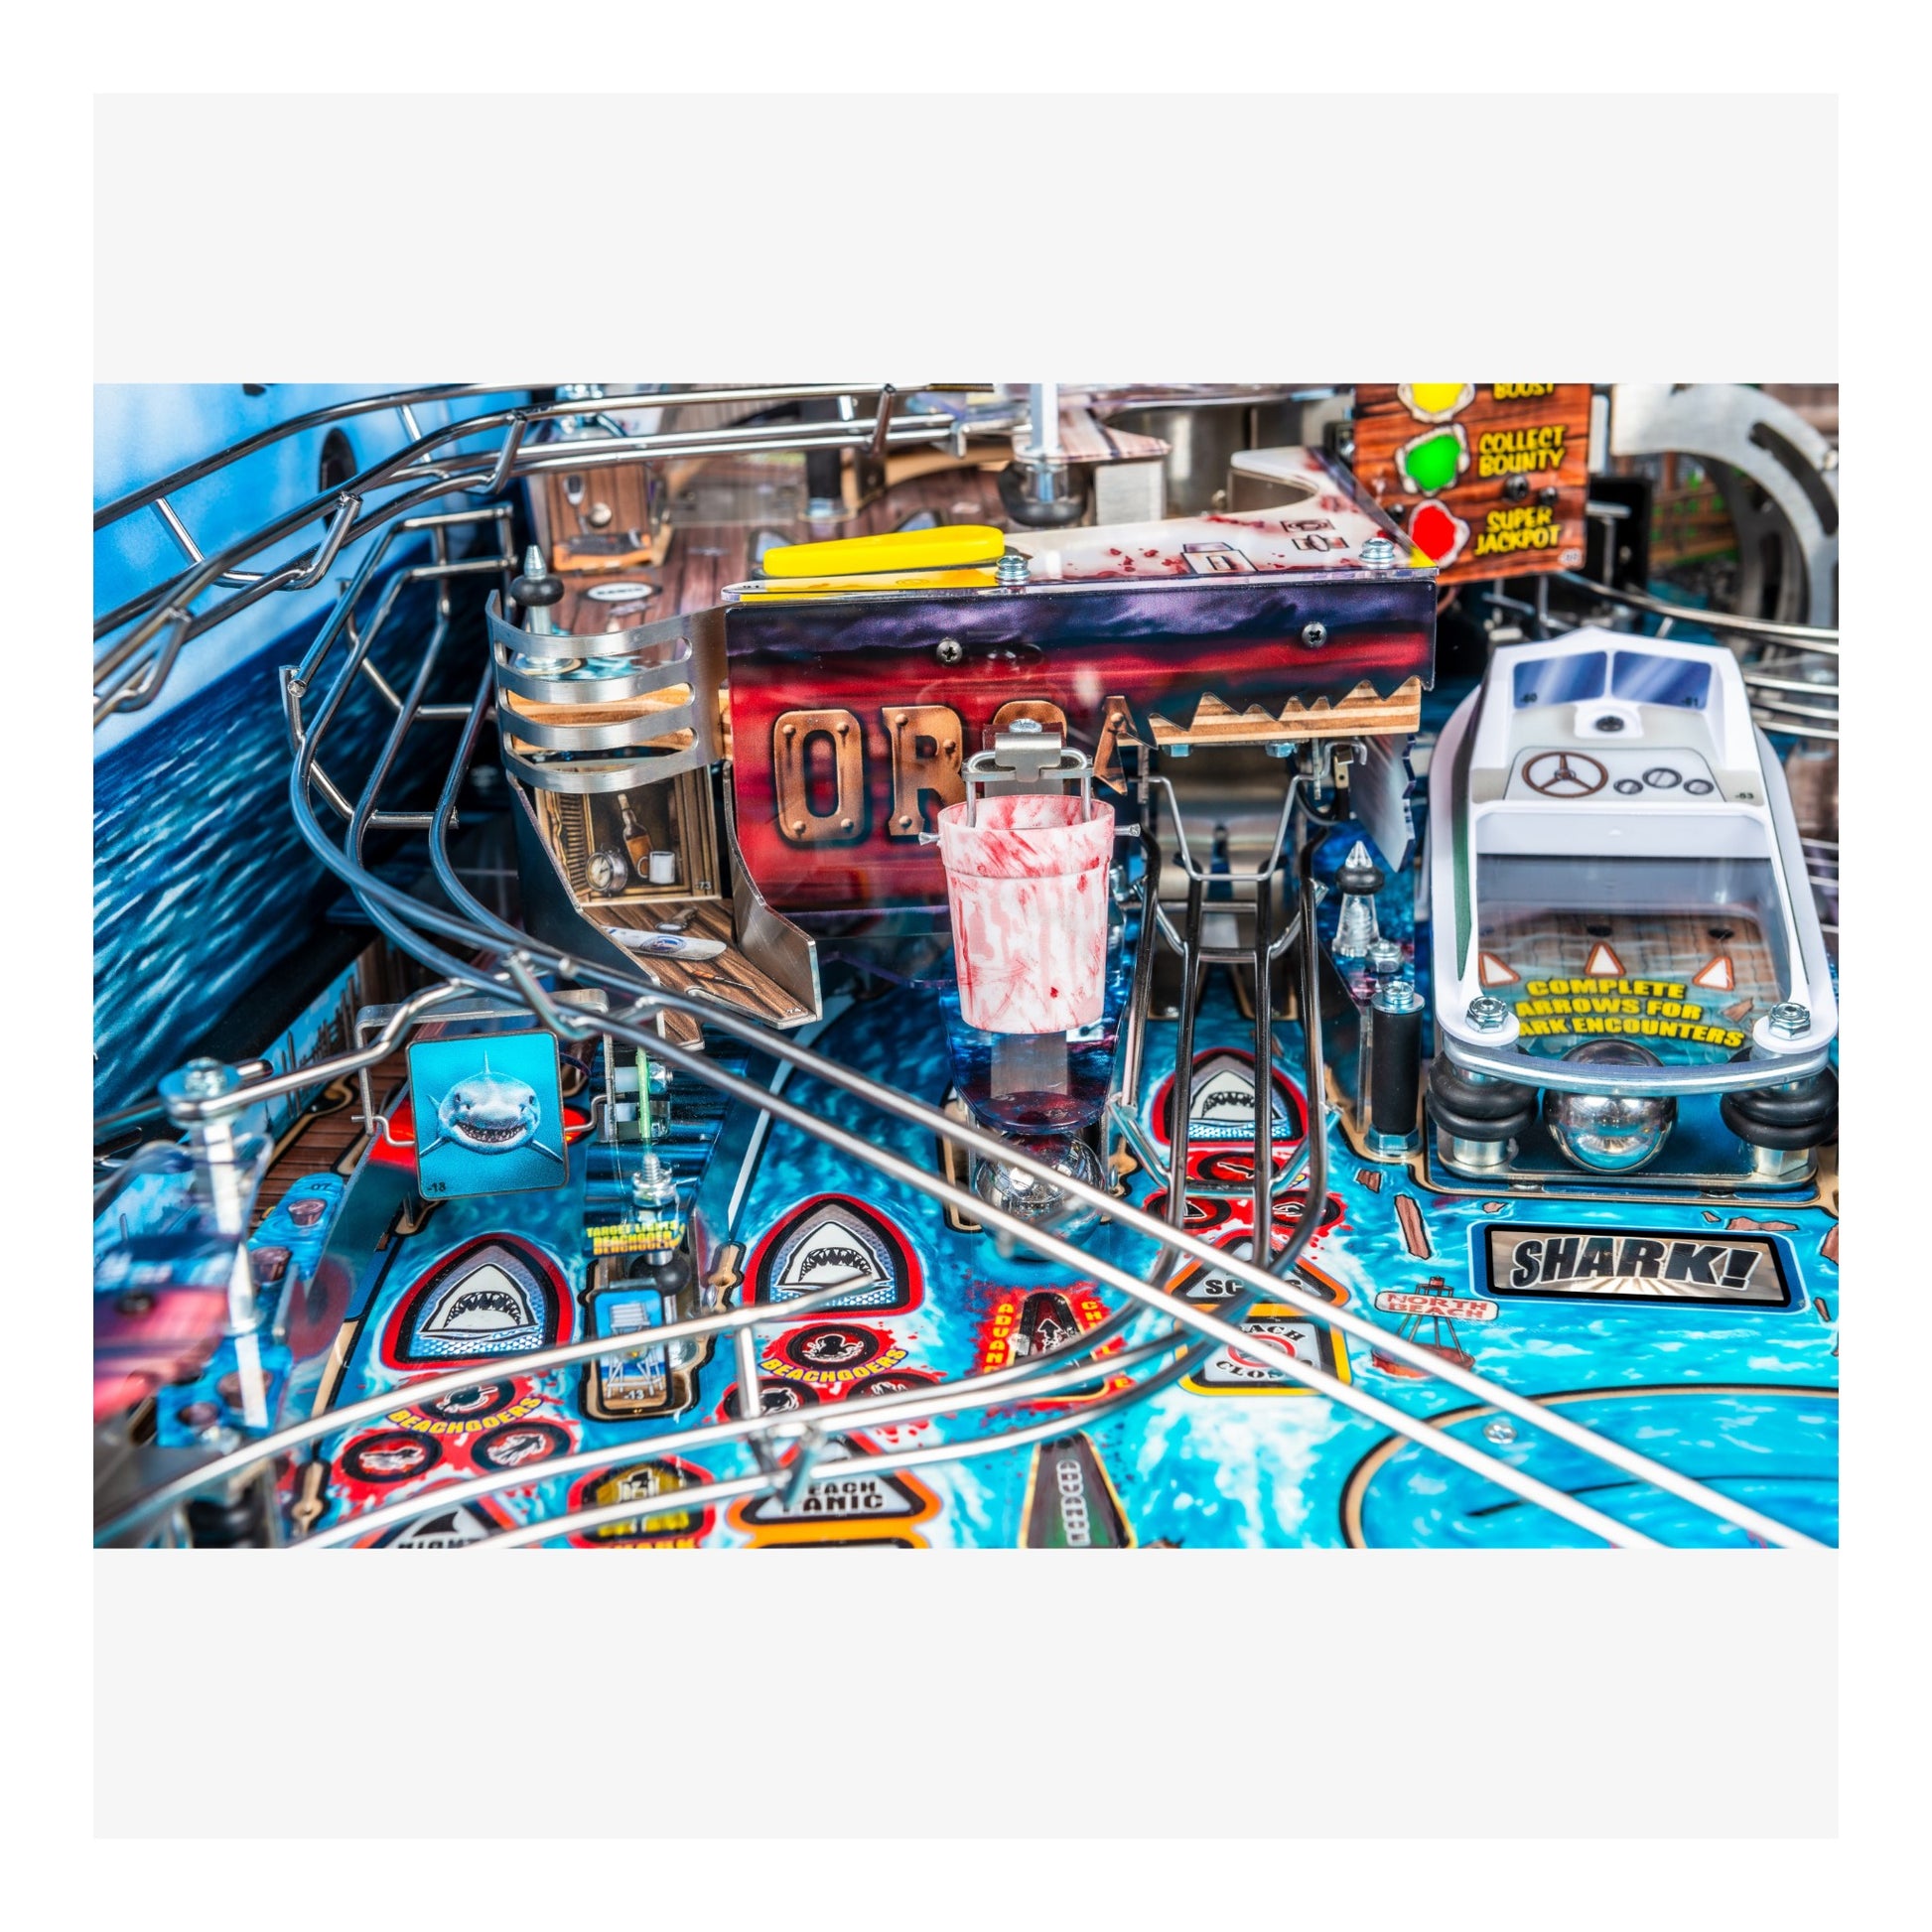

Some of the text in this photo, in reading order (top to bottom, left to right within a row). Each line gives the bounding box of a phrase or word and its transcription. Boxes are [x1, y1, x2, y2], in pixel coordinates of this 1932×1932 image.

[1479, 425, 1567, 455] COLLECT
[1478, 448, 1566, 478] BOUNTY
[1486, 506, 1553, 533] SUPER
[1474, 524, 1562, 556] JACKPOT
[696, 881, 712, 891] -73
[1526, 978, 1687, 1000] COMPLETE
[1515, 998, 1704, 1022] ARROWS FOR
[1519, 1017, 1746, 1048] ARK ENCOUNTERS
[427, 1181, 447, 1192] -18
[1509, 1236, 1763, 1291] SHARK!
[1387, 1294, 1488, 1311] NORTH
[1388, 1302, 1483, 1318] BEACH
[983, 1303, 1015, 1374] ADVAN
[1241, 1324, 1306, 1342] ACH
[759, 1347, 909, 1383] BEACHGOERS
[622, 1388, 645, 1401] -13
[385, 1395, 545, 1435] BEACHGOERS
[807, 1480, 878, 1496] EACH
[782, 1493, 885, 1514] ANIC
